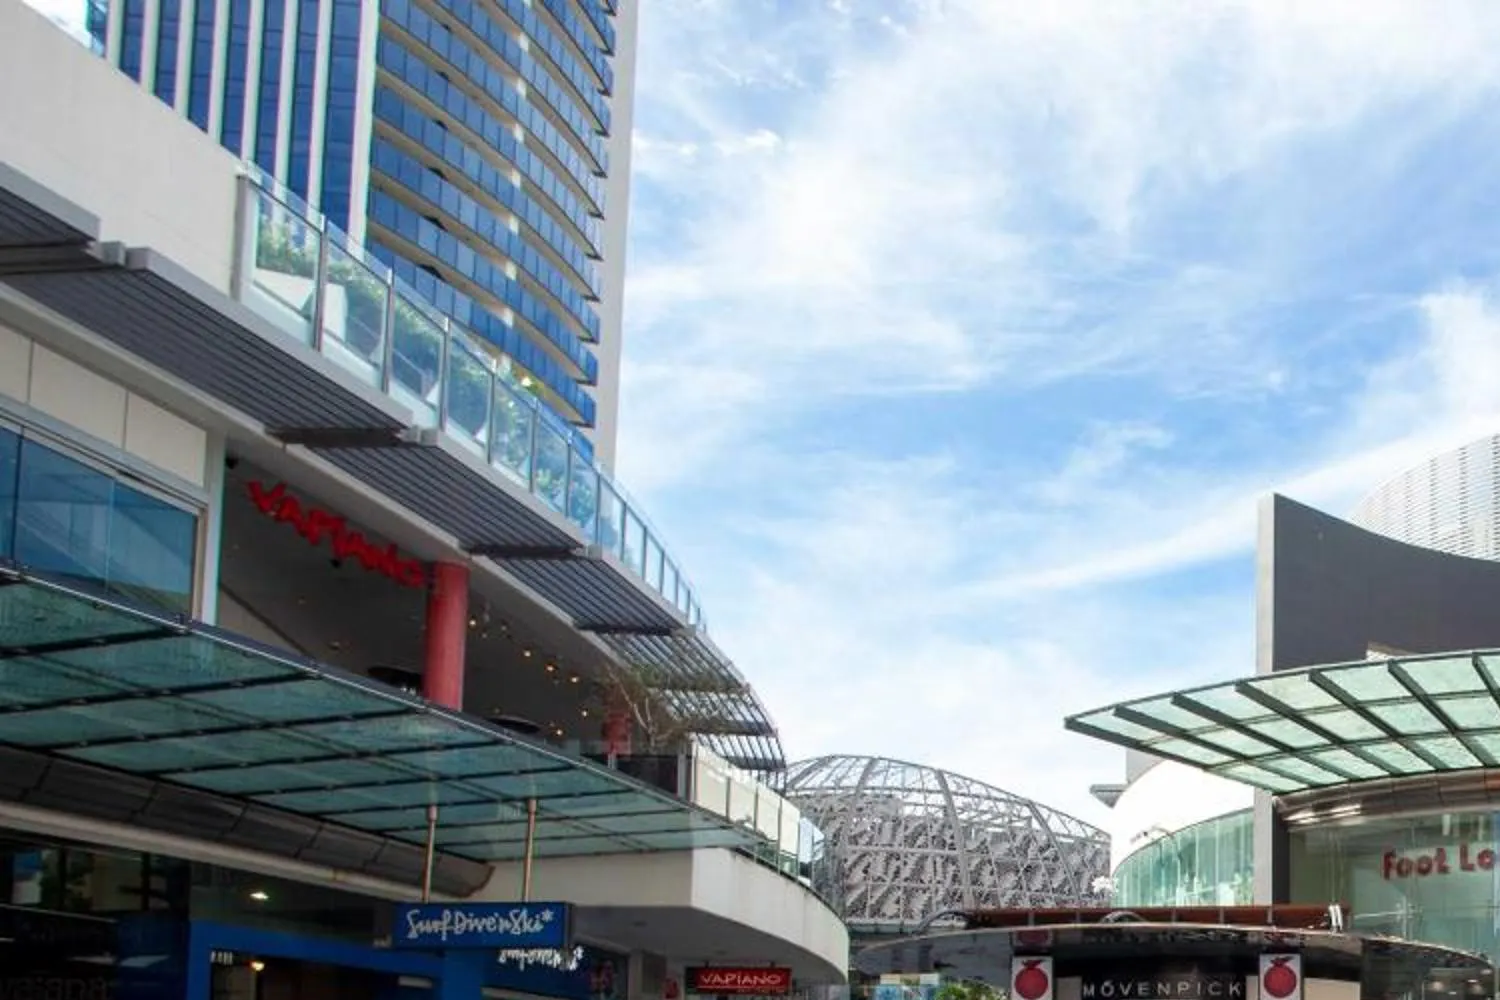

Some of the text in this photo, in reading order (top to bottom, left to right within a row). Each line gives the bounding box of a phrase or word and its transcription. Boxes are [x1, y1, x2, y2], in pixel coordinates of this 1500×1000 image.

[248, 481, 425, 588] VAPIANO
[1382, 844, 1451, 880] Foot
[700, 971, 782, 986] VAPIANO
